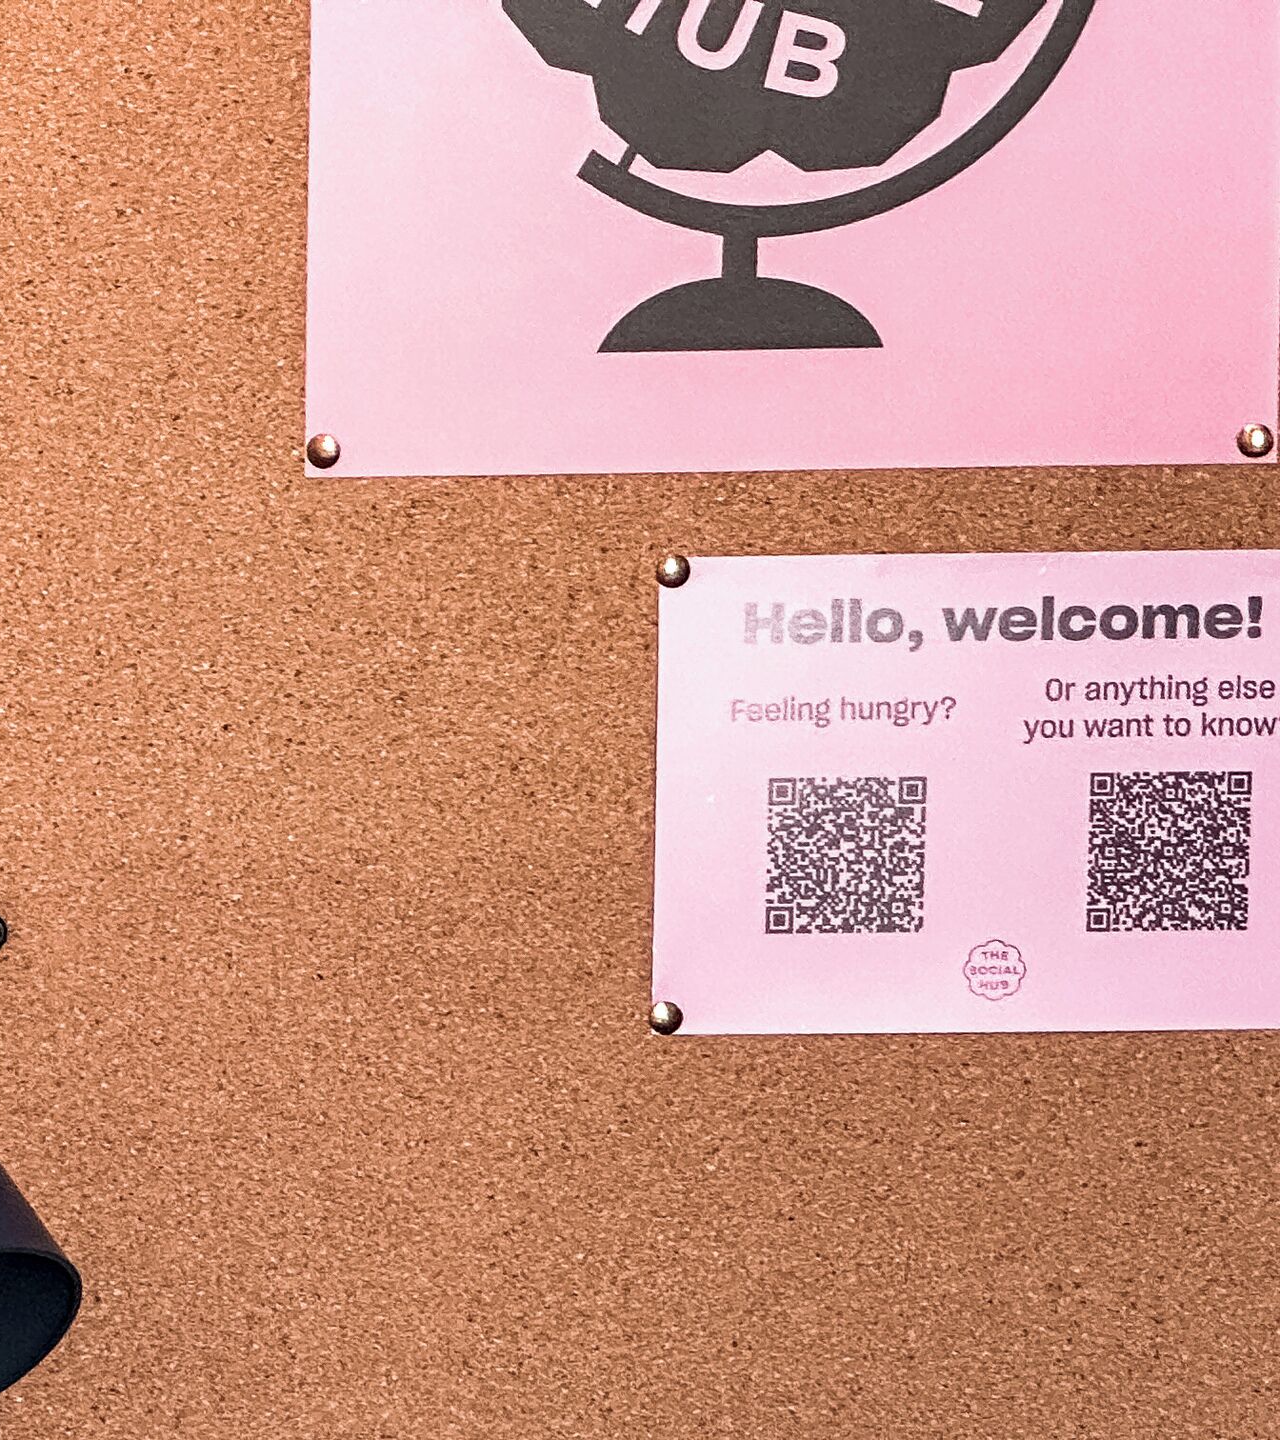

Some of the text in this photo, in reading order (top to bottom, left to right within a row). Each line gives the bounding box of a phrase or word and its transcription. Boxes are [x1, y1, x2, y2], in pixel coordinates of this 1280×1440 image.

[582, 0, 846, 98] UB
[743, 595, 1263, 652] Hello, welcome!
[1045, 674, 1276, 706] Or anything else
[730, 696, 958, 728] Feeling hungry?
[1023, 712, 1280, 744] you want to know
[969, 965, 1020, 976] SOCIAL
[981, 951, 1009, 961] THE
[977, 980, 1009, 991] HUB
